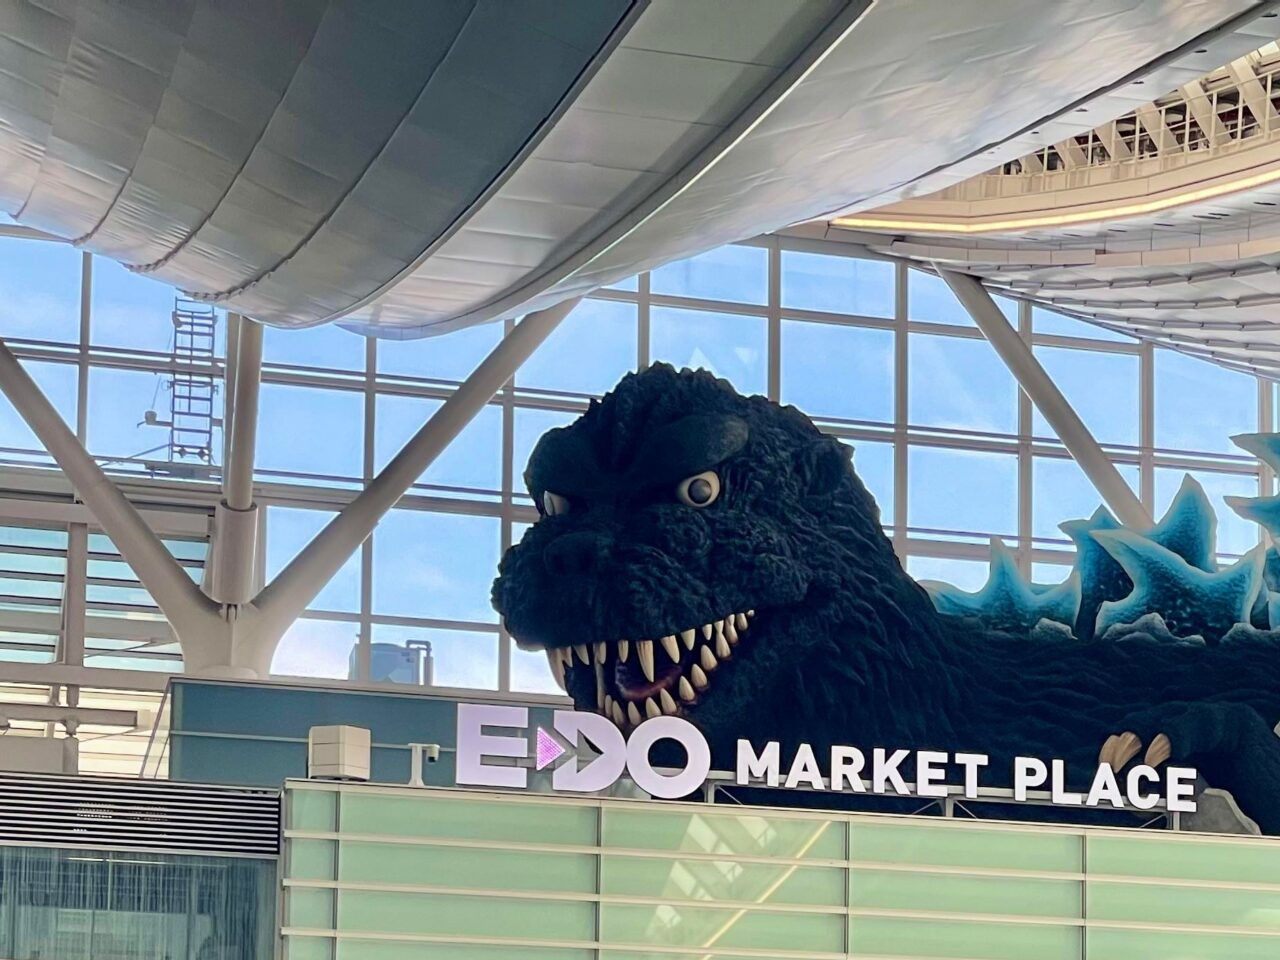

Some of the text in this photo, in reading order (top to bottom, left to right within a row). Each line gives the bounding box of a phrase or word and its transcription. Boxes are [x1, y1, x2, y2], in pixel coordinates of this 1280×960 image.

[456, 703, 1199, 812] EDO MARKET PLACE
